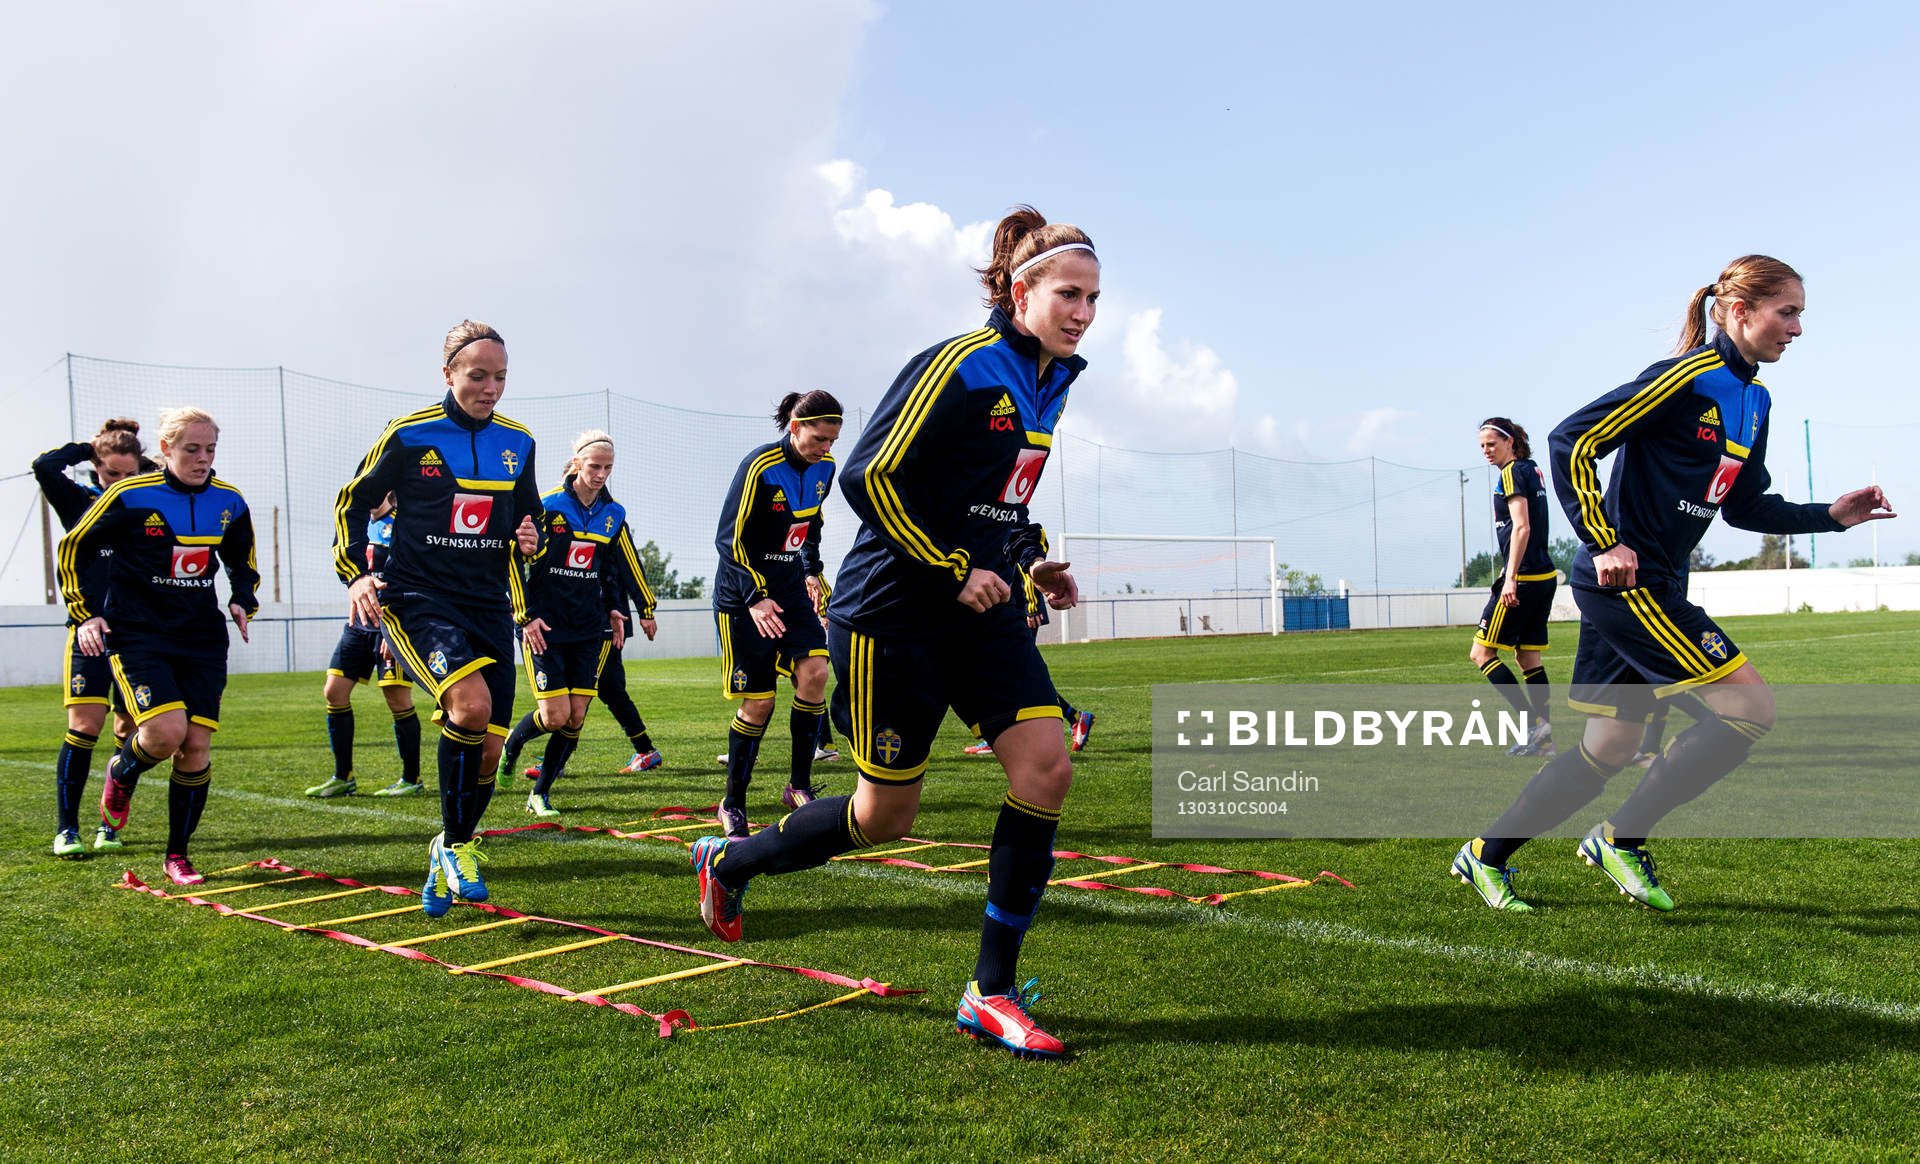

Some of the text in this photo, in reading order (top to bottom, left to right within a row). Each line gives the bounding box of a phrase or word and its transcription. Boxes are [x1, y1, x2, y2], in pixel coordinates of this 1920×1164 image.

[990, 406, 1016, 416] adidas
[989, 416, 1015, 431] ICA
[1699, 416, 1720, 426] adidas
[1696, 427, 1718, 443] ICA
[421, 467, 442, 477] ICA
[145, 527, 165, 536] ICA
[426, 534, 504, 549] SVENSKA SPEL
[549, 567, 584, 578] SVENSKA
[152, 576, 201, 588] SVENSKA
